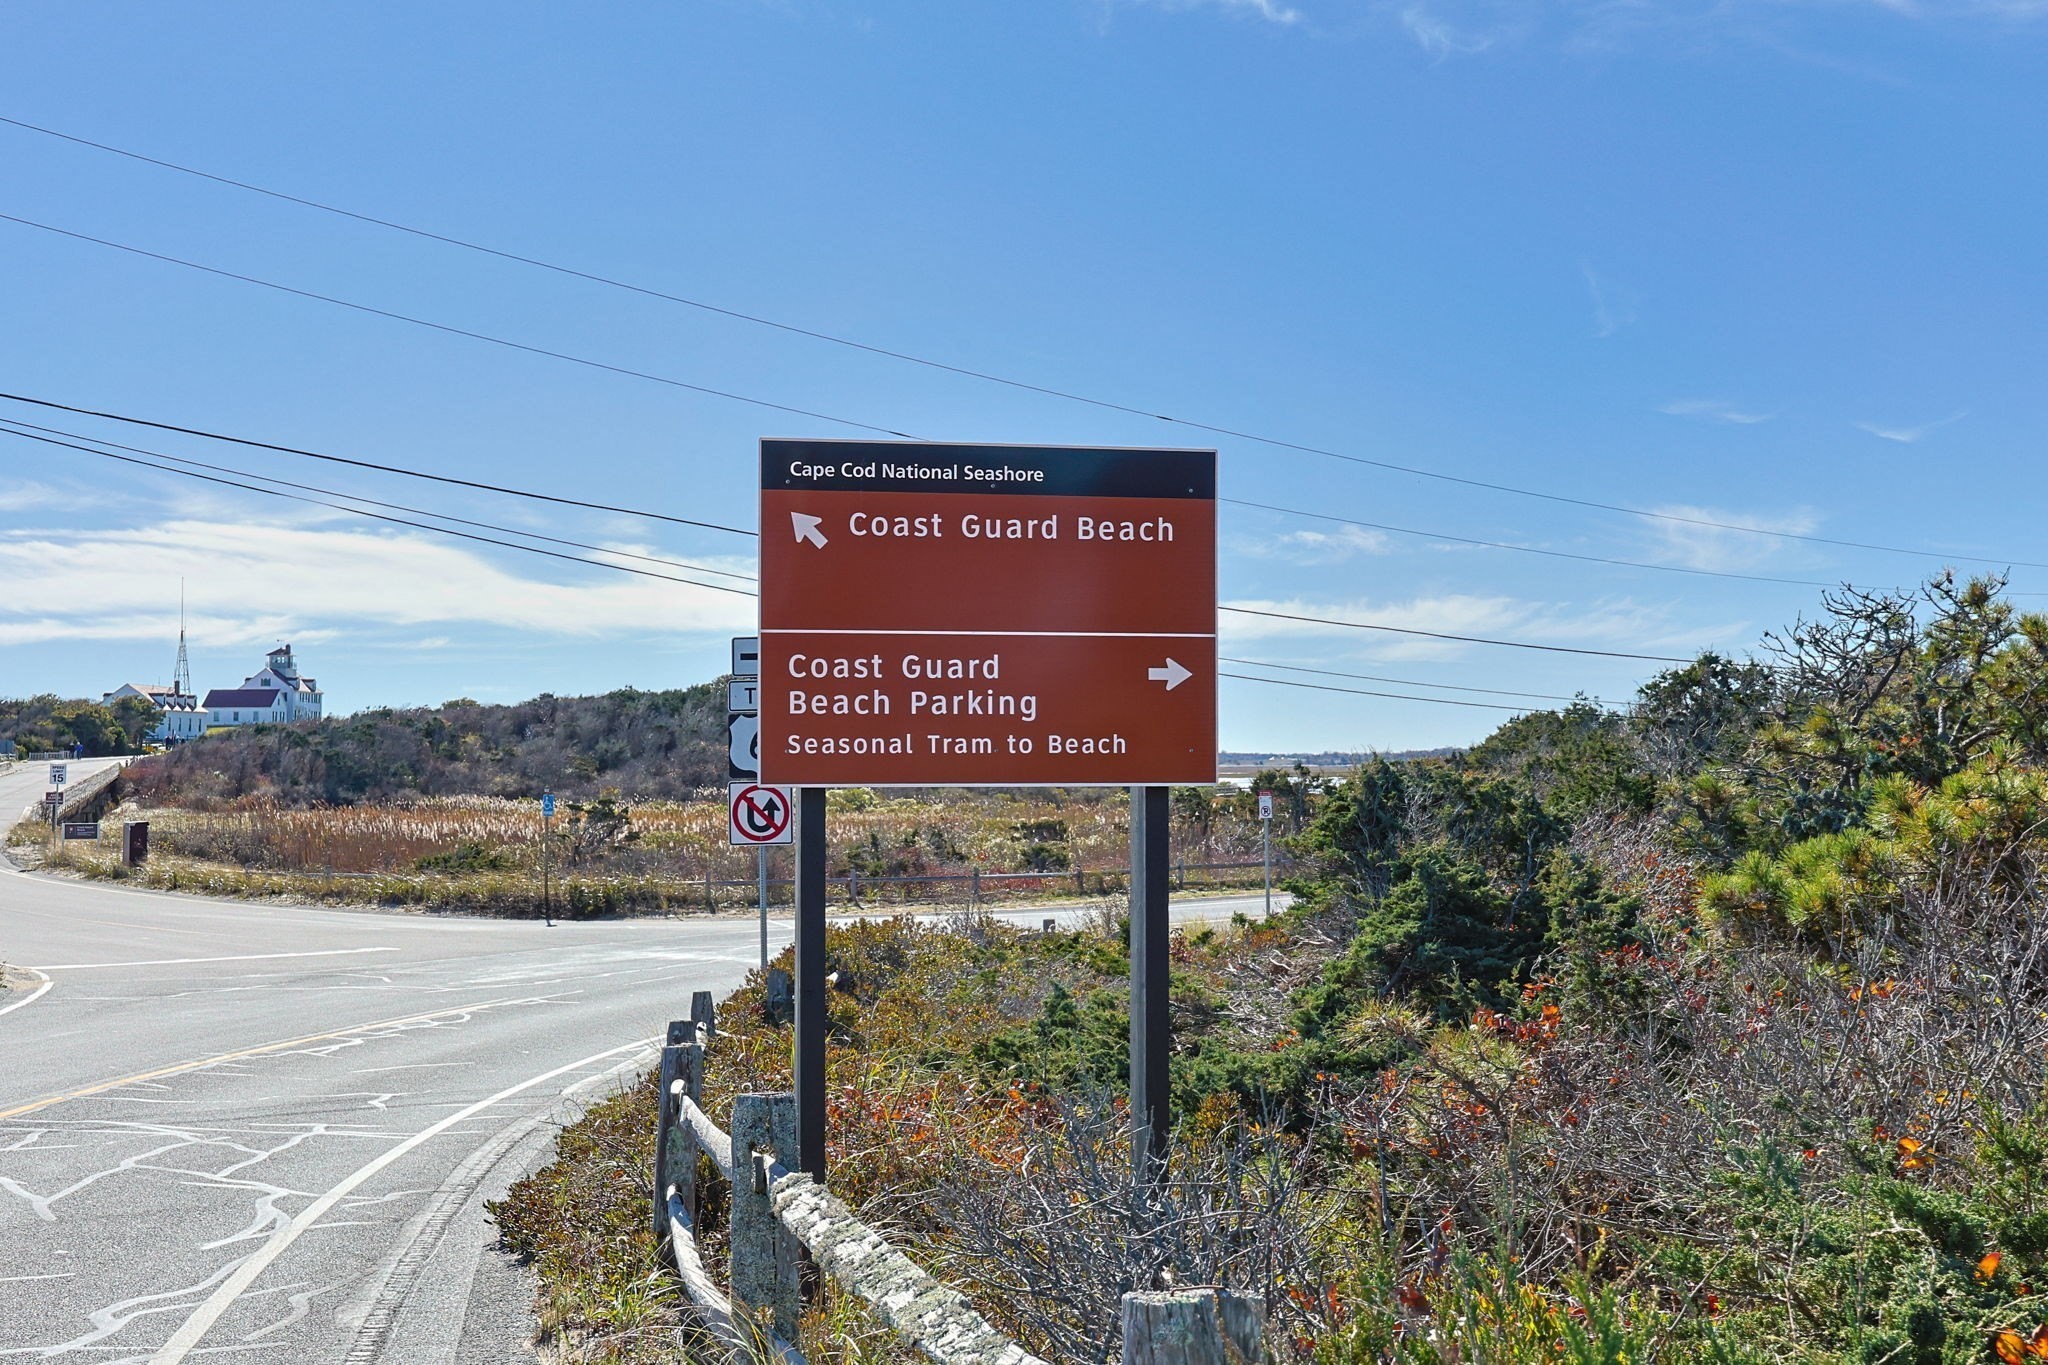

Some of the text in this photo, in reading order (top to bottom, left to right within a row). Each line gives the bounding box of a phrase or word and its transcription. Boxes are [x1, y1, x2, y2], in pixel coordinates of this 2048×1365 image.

[790, 462, 1044, 482] Cape Cod National Seashore
[849, 512, 1173, 541] Coast Guard Beach
[788, 654, 999, 679] Coast Guard
[789, 690, 1037, 722] Beach Parking
[787, 734, 1126, 754] Seasonal Tram to Beach
[52, 774, 64, 783] 15
